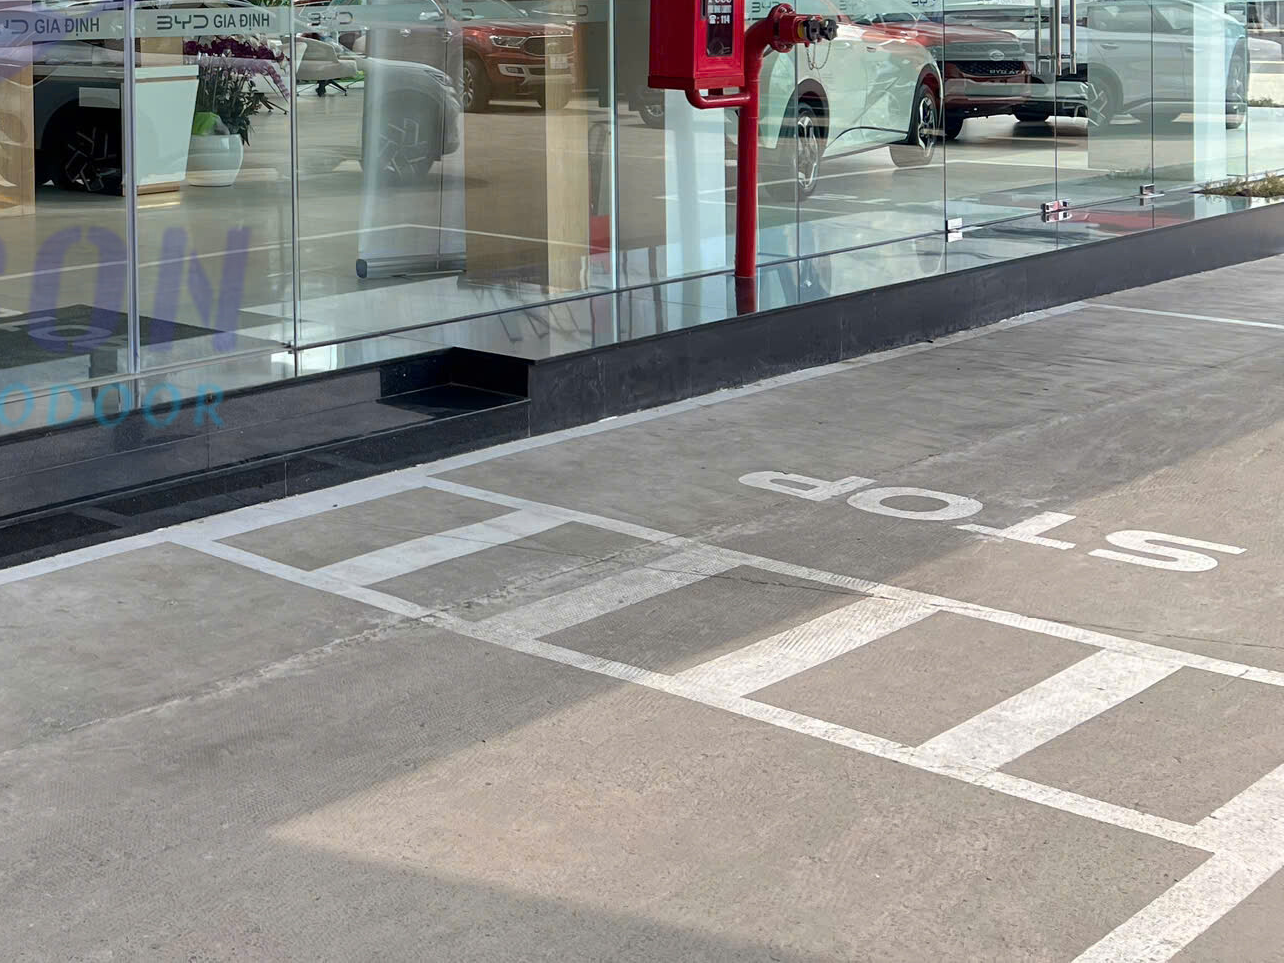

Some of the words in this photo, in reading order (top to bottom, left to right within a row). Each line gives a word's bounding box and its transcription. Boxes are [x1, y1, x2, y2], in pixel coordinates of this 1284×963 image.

[34, 18, 62, 35] GIA
[64, 17, 101, 37] ĐỊNH
[156, 14, 209, 30] BYD
[213, 13, 237, 29] GIA
[239, 13, 271, 32] ĐỊNH
[738, 470, 1248, 573] STOP
